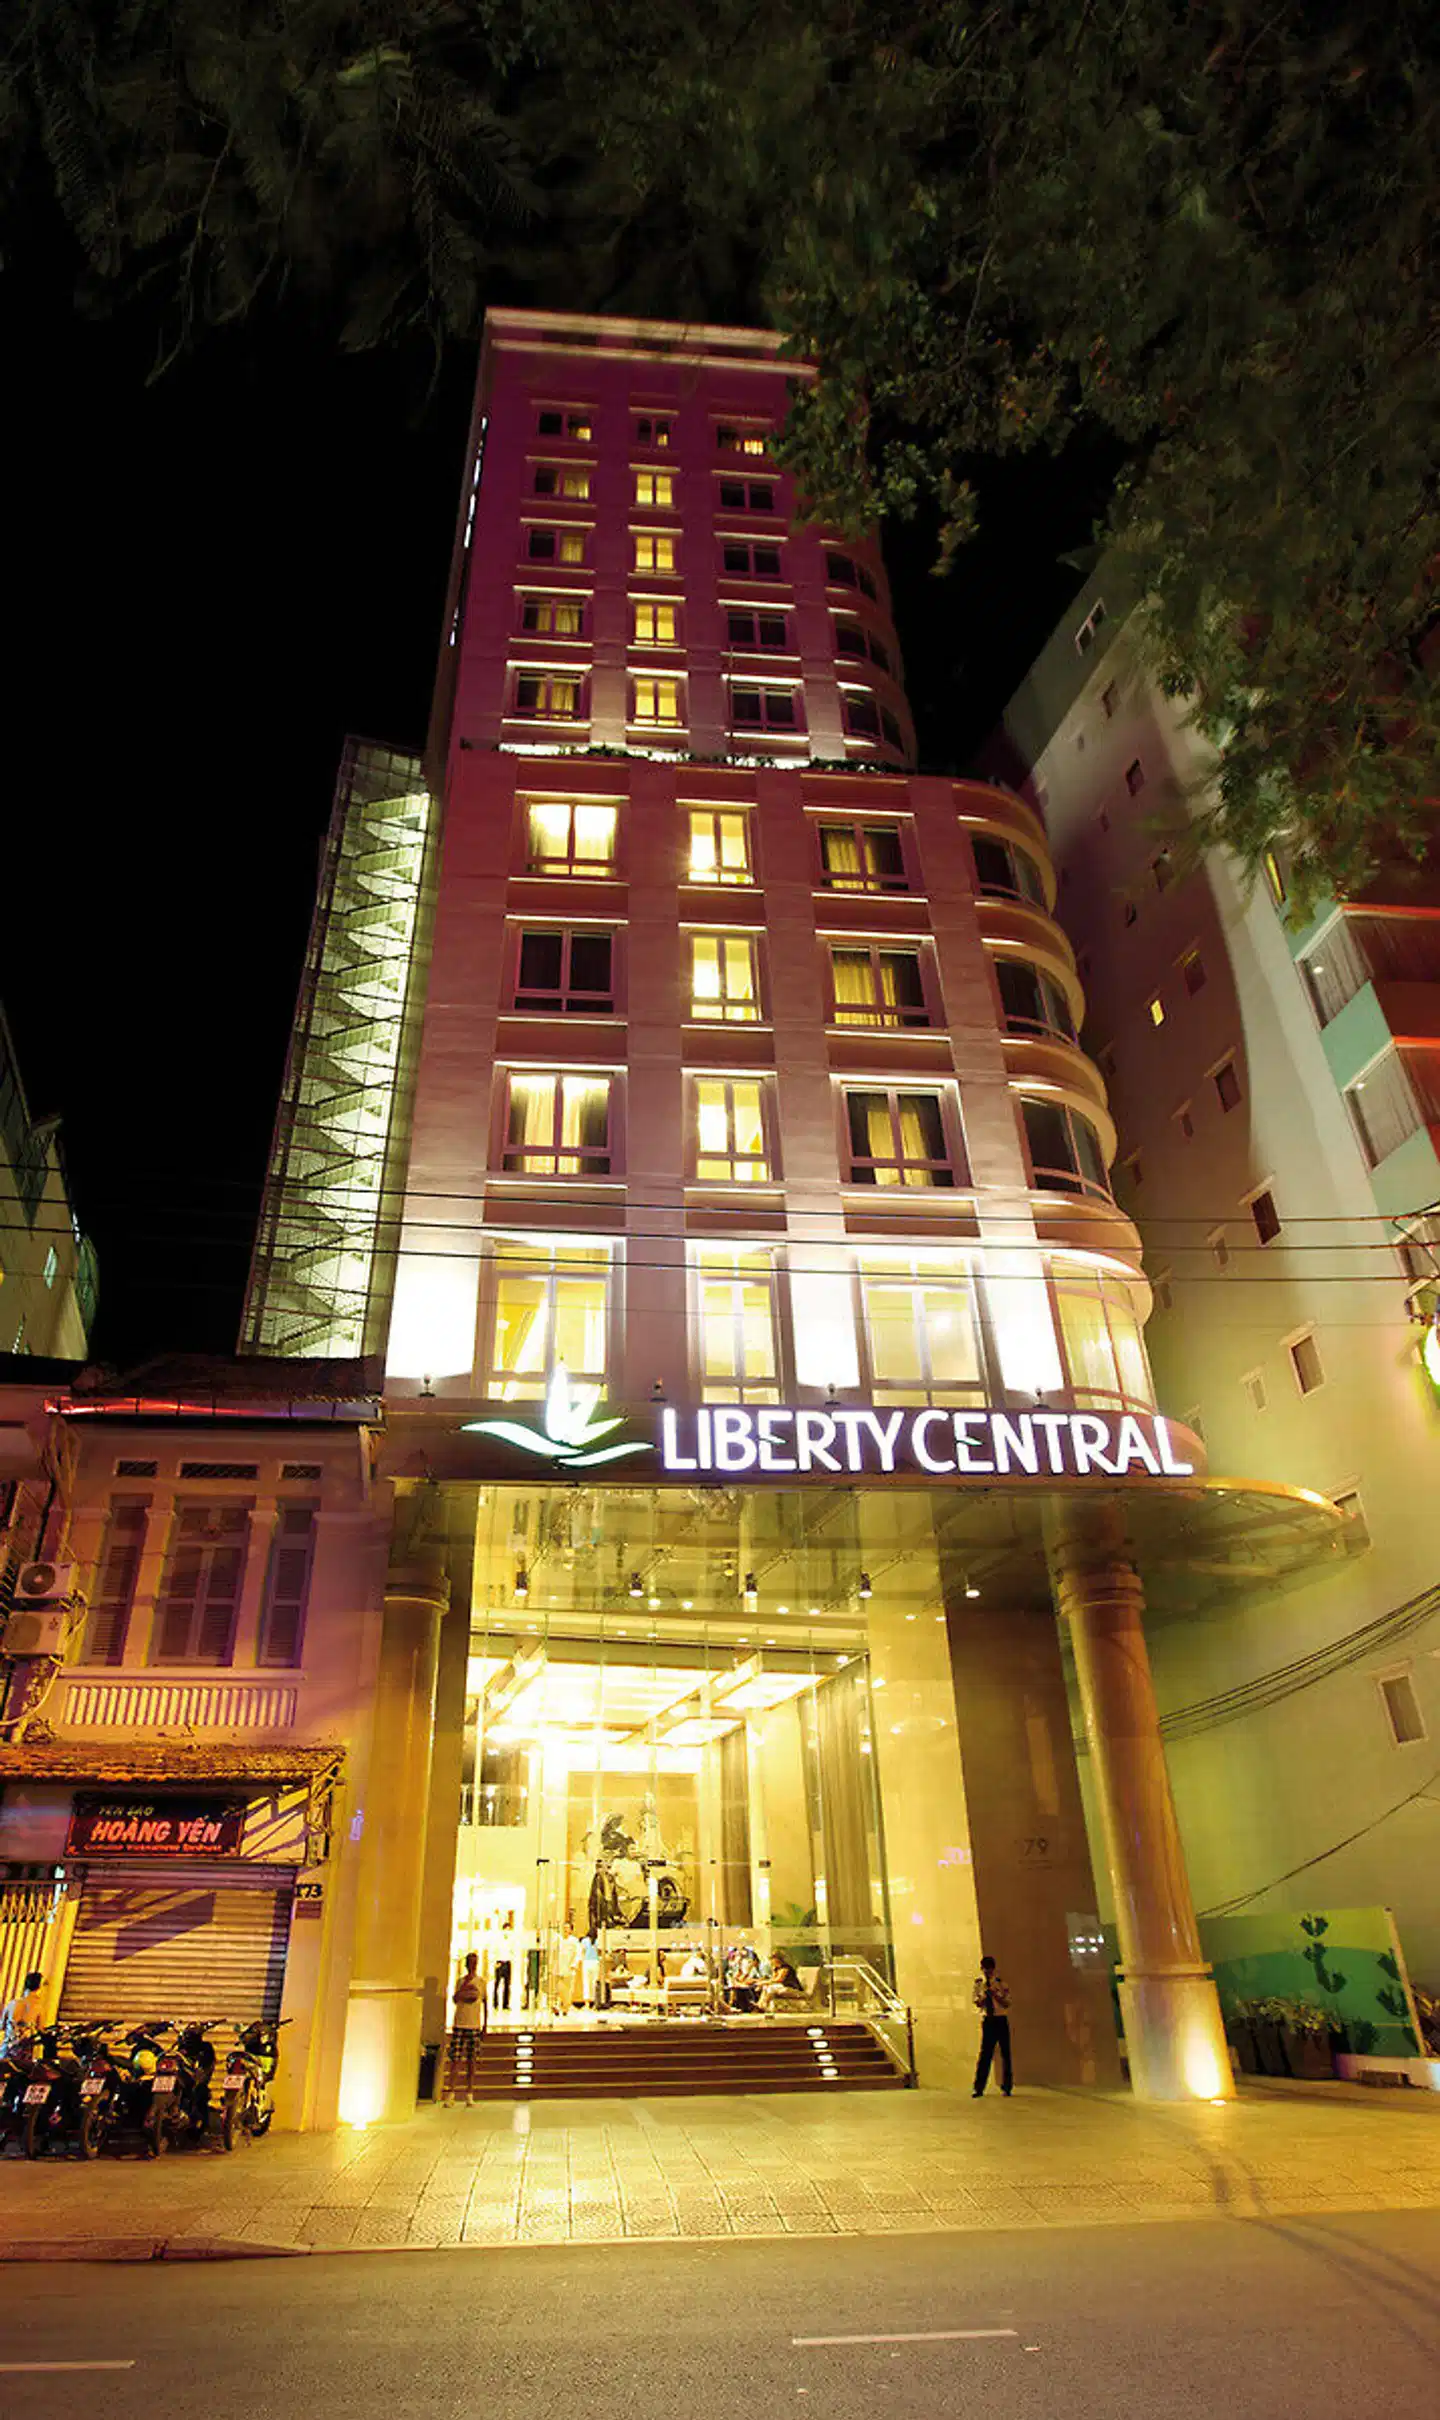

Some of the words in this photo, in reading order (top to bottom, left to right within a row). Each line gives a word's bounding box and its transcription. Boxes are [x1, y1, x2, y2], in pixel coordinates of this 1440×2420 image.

[661, 1407, 904, 1473] LIBERTY
[911, 1408, 1194, 1477] CENTRAL
[90, 1816, 172, 1842] HOÀNG
[177, 1814, 223, 1843] YẾN
